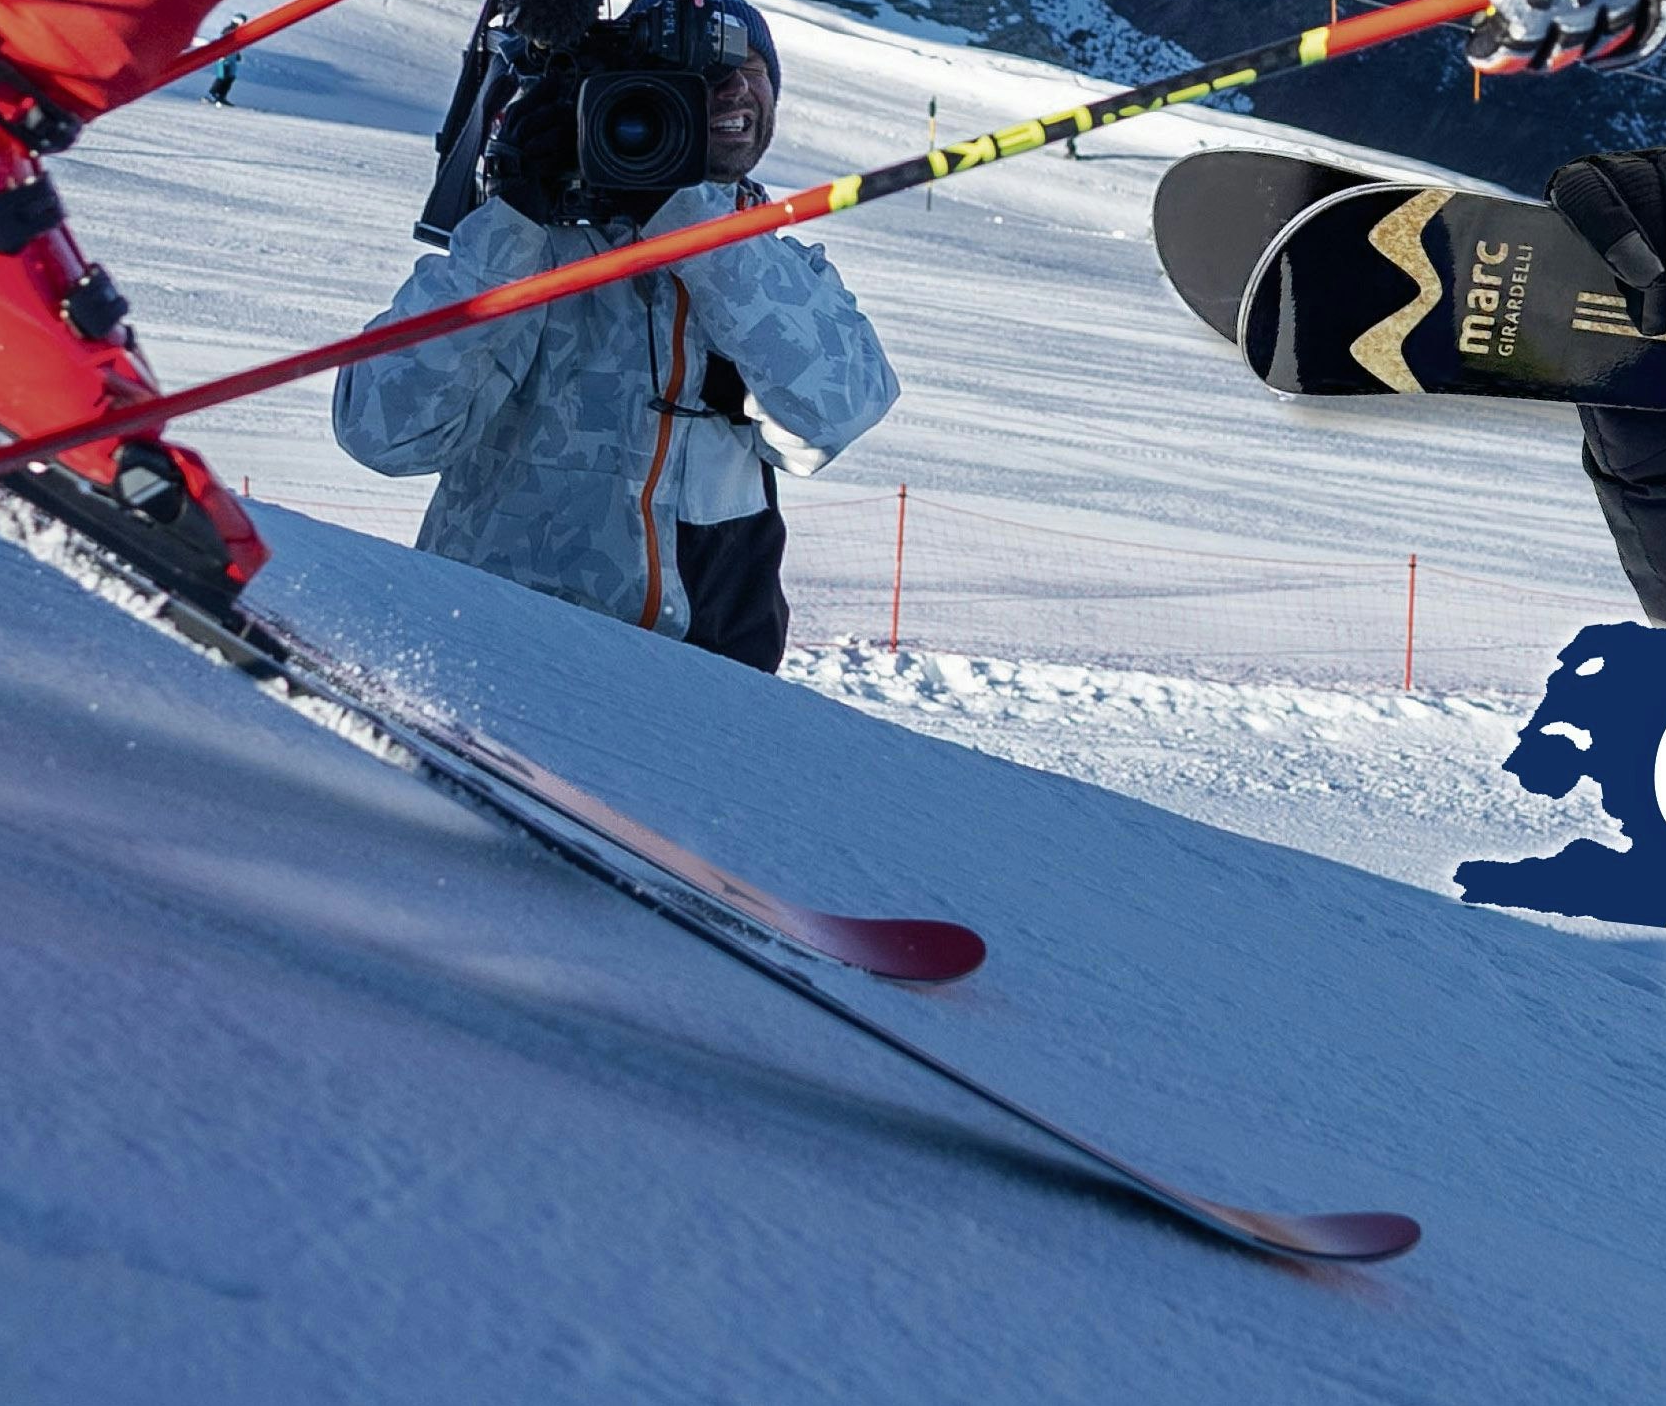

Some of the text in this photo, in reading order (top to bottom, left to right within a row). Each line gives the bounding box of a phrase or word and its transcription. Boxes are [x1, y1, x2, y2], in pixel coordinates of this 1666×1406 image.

[927, 105, 1093, 179] LEKI
[1459, 241, 1509, 354] marc
[1498, 244, 1533, 357] GIRARDELLI
